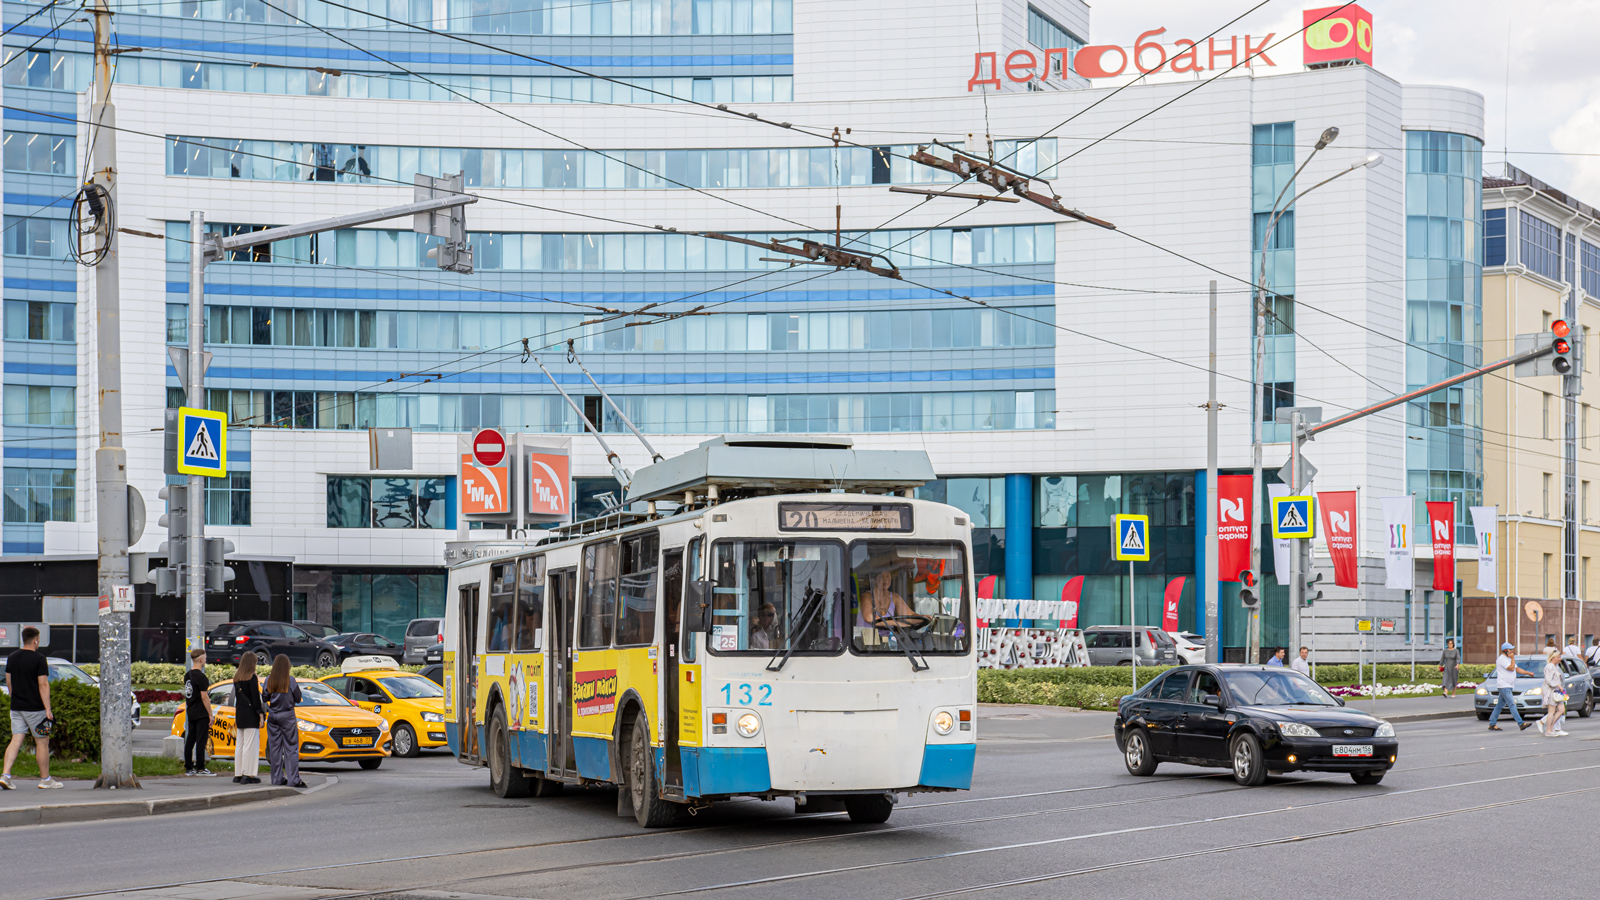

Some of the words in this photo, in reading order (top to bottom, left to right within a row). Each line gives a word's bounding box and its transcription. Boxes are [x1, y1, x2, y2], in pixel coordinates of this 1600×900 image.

[968, 26, 1277, 92] делобанк
[464, 479, 495, 510] ТМК
[533, 478, 559, 511] ТМК
[789, 511, 819, 528] 20
[1018, 598, 1077, 620] КВАРТИР
[721, 637, 736, 648] 25
[720, 683, 773, 706] 132
